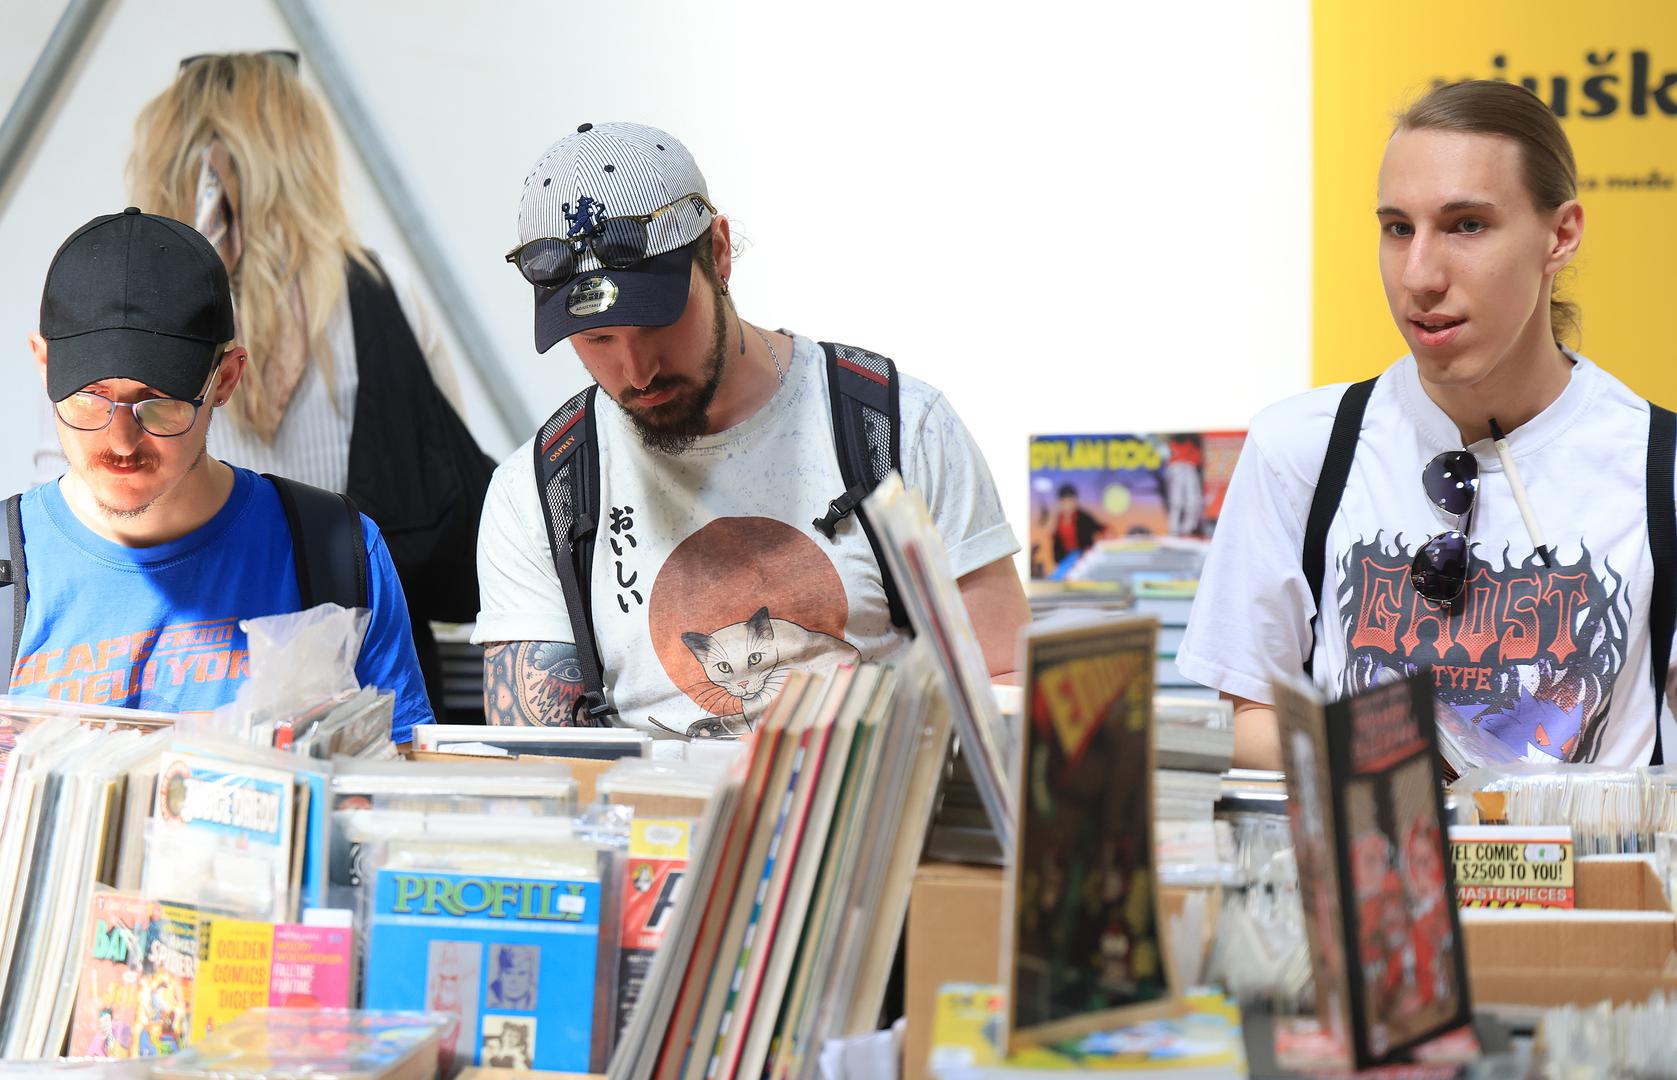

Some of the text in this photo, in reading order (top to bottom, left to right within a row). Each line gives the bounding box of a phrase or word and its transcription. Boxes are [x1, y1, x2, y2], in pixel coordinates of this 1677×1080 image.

[549, 434, 575, 462] OSPREY
[609, 505, 643, 614] おいしい
[1351, 556, 1589, 664] GHOST
[1432, 664, 1493, 691] TYPE
[1476, 845, 1519, 862] COMIC
[1463, 863, 1563, 881] $2500 TO YOU!
[216, 940, 268, 961] GOLDEN
[212, 964, 267, 986] COMICS
[218, 988, 264, 1011] DIGEST
